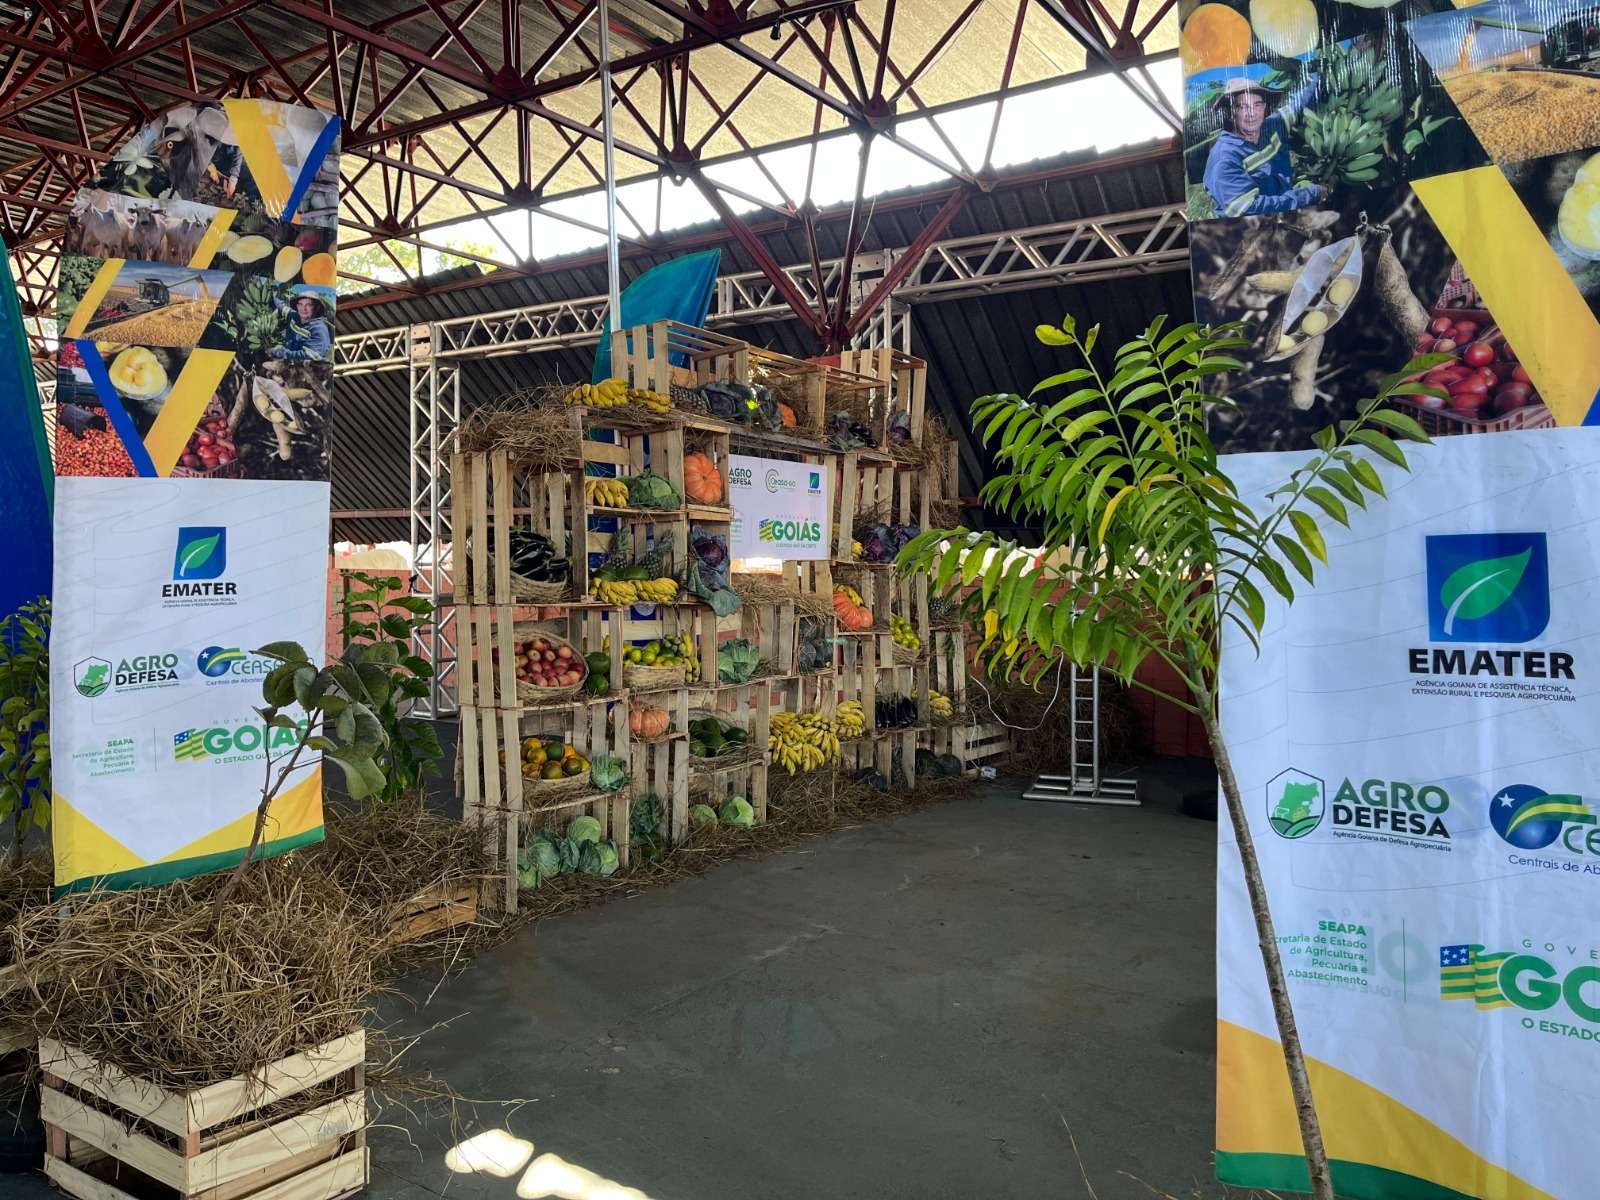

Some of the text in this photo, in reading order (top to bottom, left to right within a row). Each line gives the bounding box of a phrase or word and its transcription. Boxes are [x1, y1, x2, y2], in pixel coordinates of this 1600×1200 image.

[729, 468, 752, 478] AGRO
[772, 517, 821, 542] GOIÁS
[162, 582, 237, 598] EMATER
[116, 653, 179, 674] AGRO
[1408, 648, 1576, 680] EMATER
[116, 668, 179, 686] DEFESA
[1412, 688, 1448, 696] EXTENSÃO
[1480, 691, 1516, 700] PESQUISA
[1517, 692, 1577, 702] AGROPECUÁRIA
[1415, 679, 1446, 688] AGÊNCIA
[1447, 681, 1476, 689] GOIANA
[1489, 682, 1537, 692] ASSISTÊNCIA
[1537, 683, 1572, 694] TÉCNICA,
[107, 738, 134, 748] SEAPA
[72, 750, 103, 760] Secretaria
[223, 755, 254, 764] ESTADO
[1332, 776, 1450, 815] AGRO
[1332, 804, 1451, 839] DEFESA
[1332, 831, 1452, 852] Agência Goiana de Defesa Agropecuária
[1508, 854, 1559, 870] Centrais
[1562, 861, 1580, 873] de
[1318, 920, 1367, 937] SEAPA
[1313, 934, 1327, 944] de
[1329, 936, 1367, 950] Estado
[1289, 946, 1367, 963] de Agricultura,
[1311, 958, 1368, 974] Pecuária e
[1287, 969, 1368, 986] Abastecimento
[1521, 1017, 1535, 1029] O
